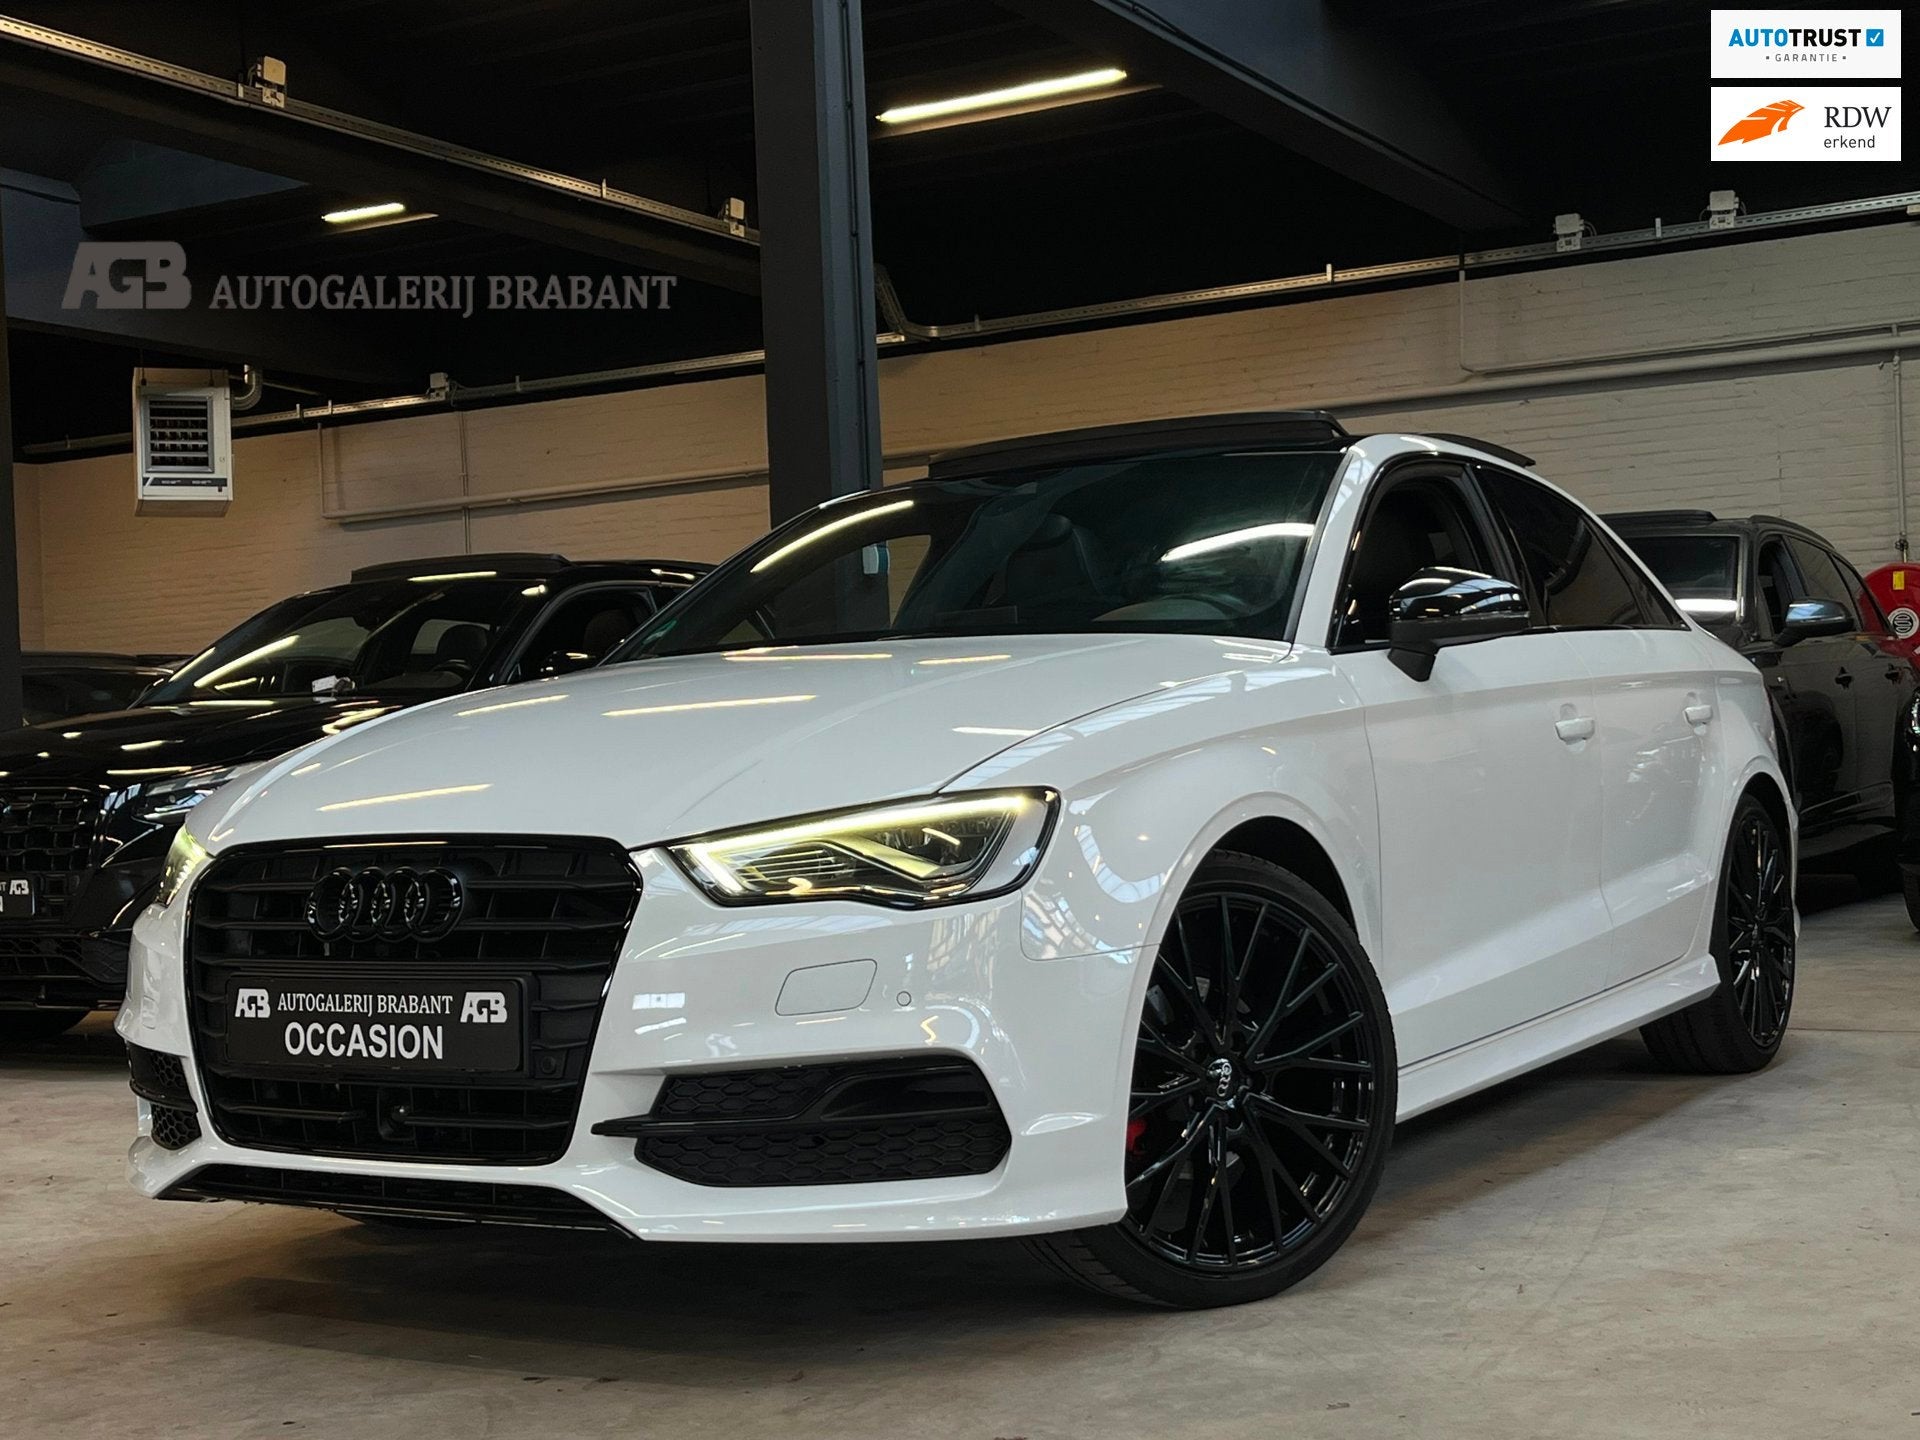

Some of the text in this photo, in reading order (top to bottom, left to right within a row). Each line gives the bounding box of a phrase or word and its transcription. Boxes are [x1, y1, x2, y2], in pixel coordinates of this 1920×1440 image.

[234, 988, 508, 1023] AGB AUTOGALERIJ BRABANT AGB
[284, 1021, 443, 1059] OCCASION
